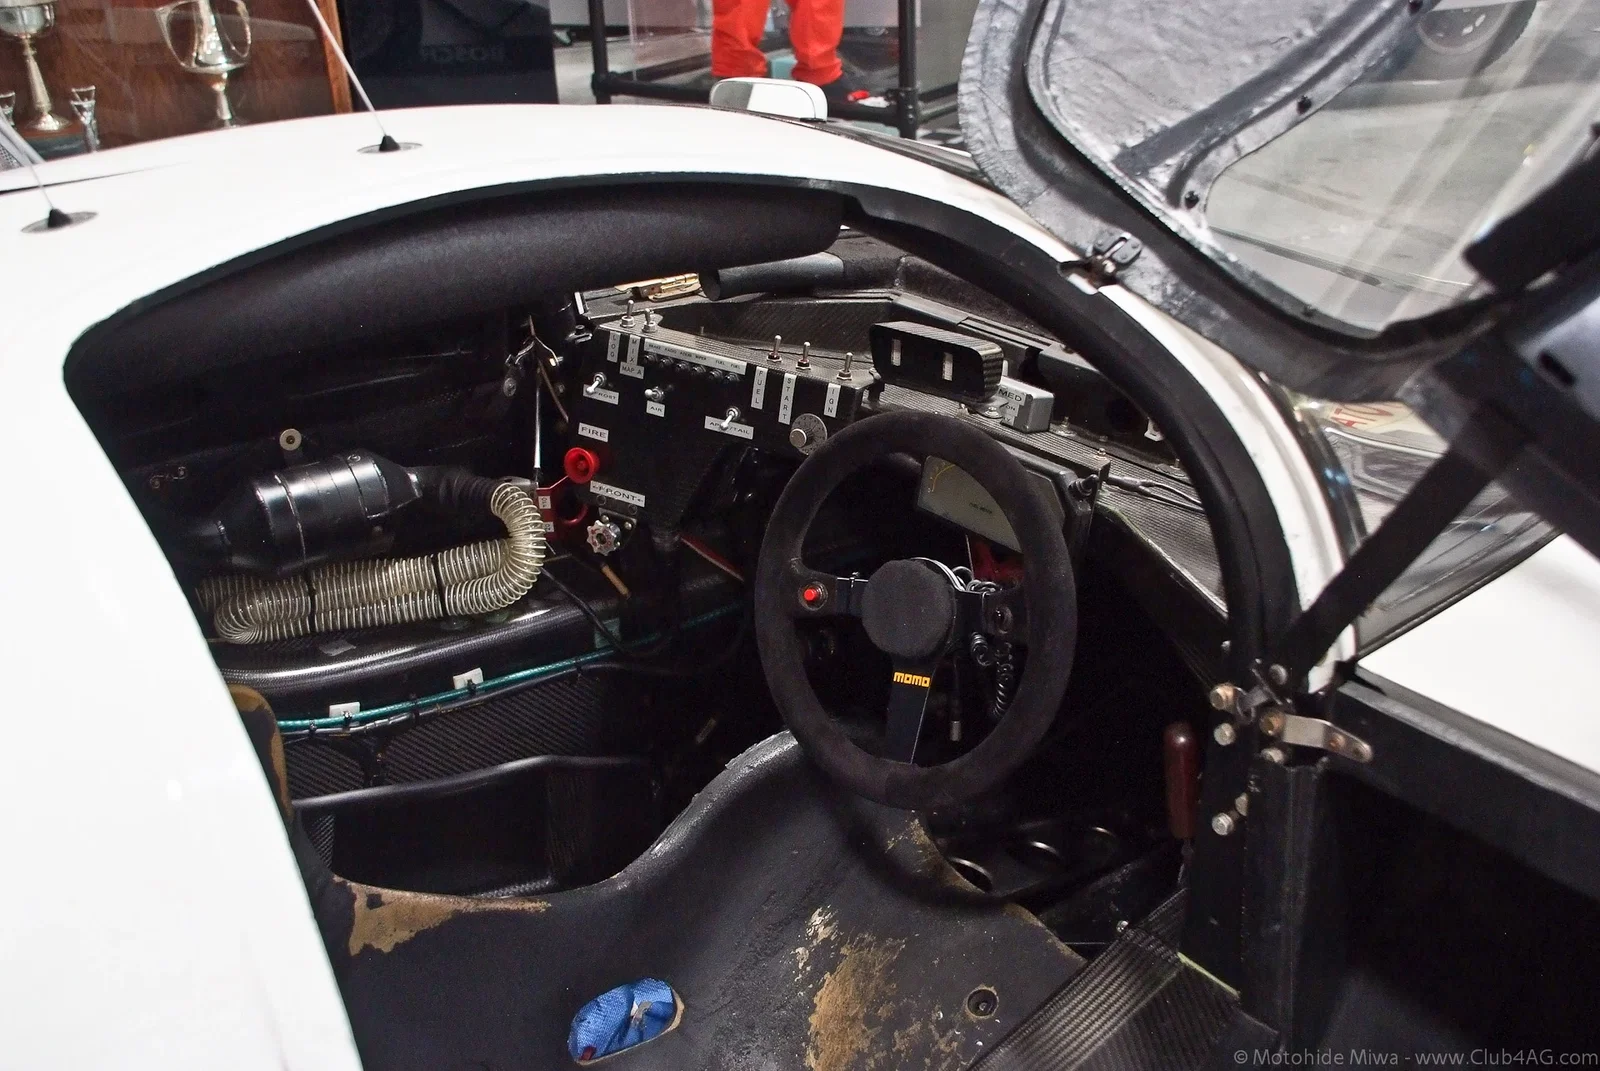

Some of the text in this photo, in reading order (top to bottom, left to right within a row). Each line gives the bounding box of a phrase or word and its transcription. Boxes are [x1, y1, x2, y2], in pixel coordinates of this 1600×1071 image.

[629, 339, 638, 363] MIX
[621, 365, 635, 374] MAP
[755, 370, 764, 404] FUEL
[999, 388, 1022, 402] MED
[782, 377, 792, 420] START
[827, 388, 835, 414] IGN
[650, 405, 663, 413] AIR
[580, 426, 607, 439] FIRE
